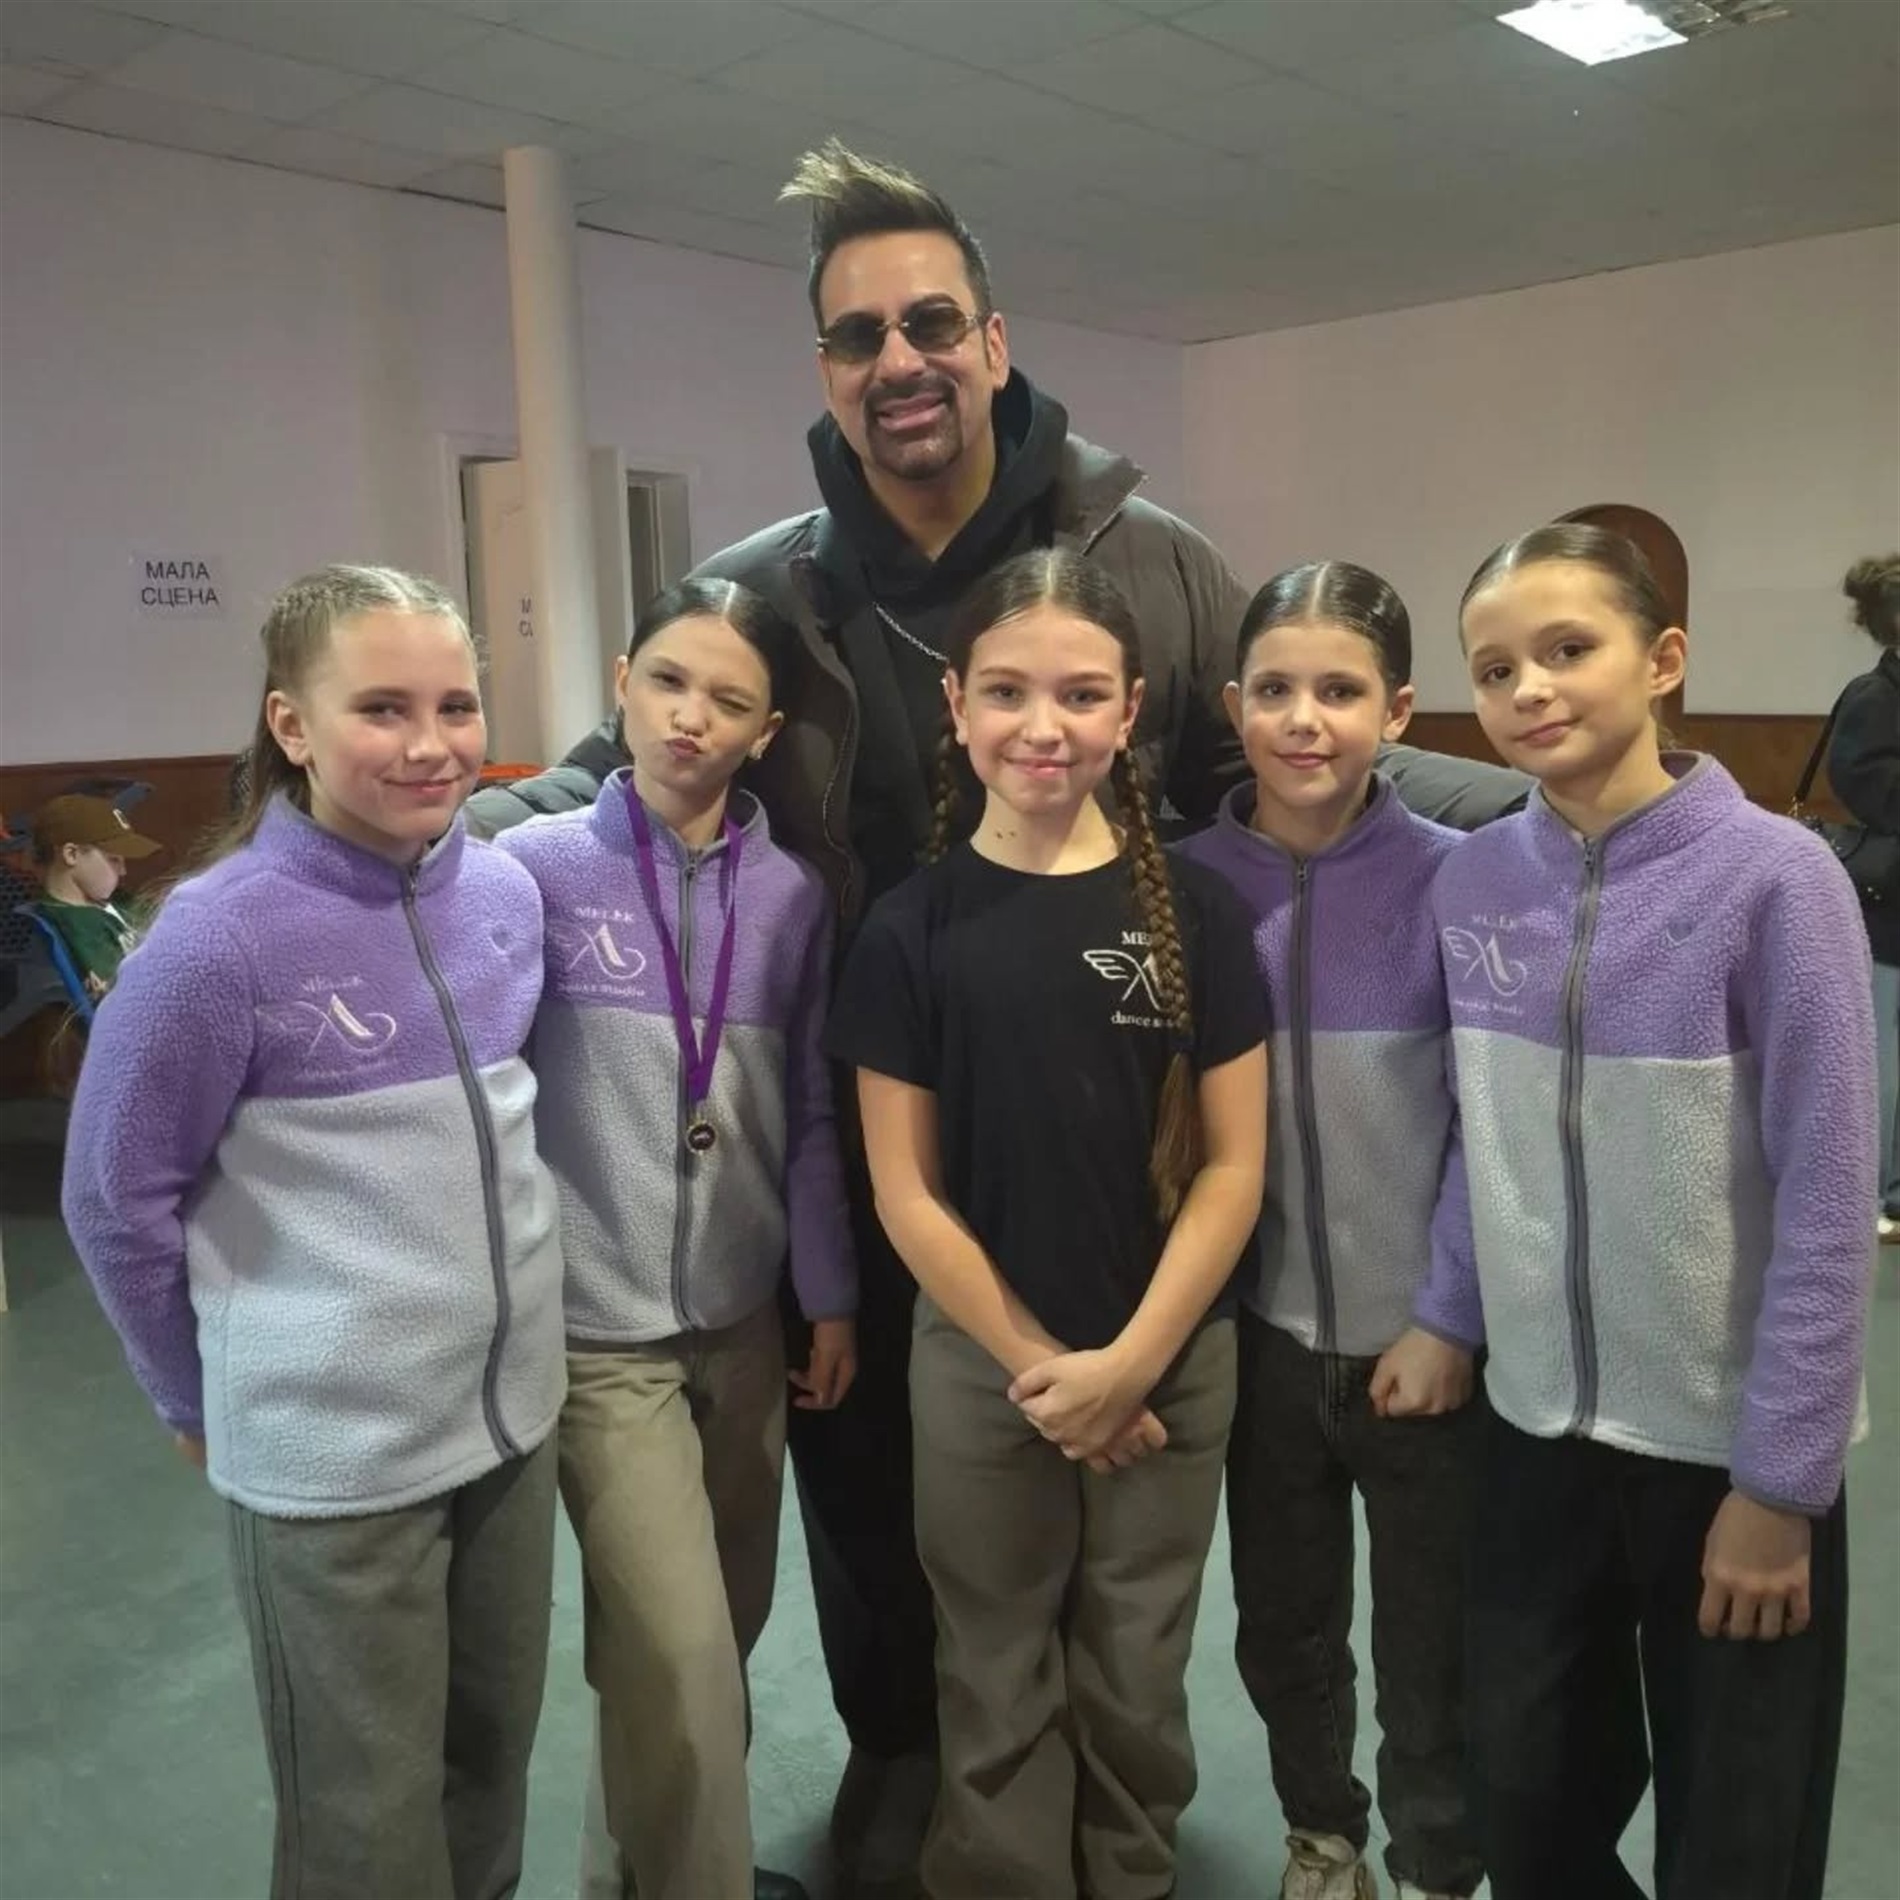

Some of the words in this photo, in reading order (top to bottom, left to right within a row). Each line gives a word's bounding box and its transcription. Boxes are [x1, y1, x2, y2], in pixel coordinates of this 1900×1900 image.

[145, 561, 210, 580] МАЛА
[141, 587, 219, 608] СЦЕНА
[1111, 1010, 1151, 1026] dance
